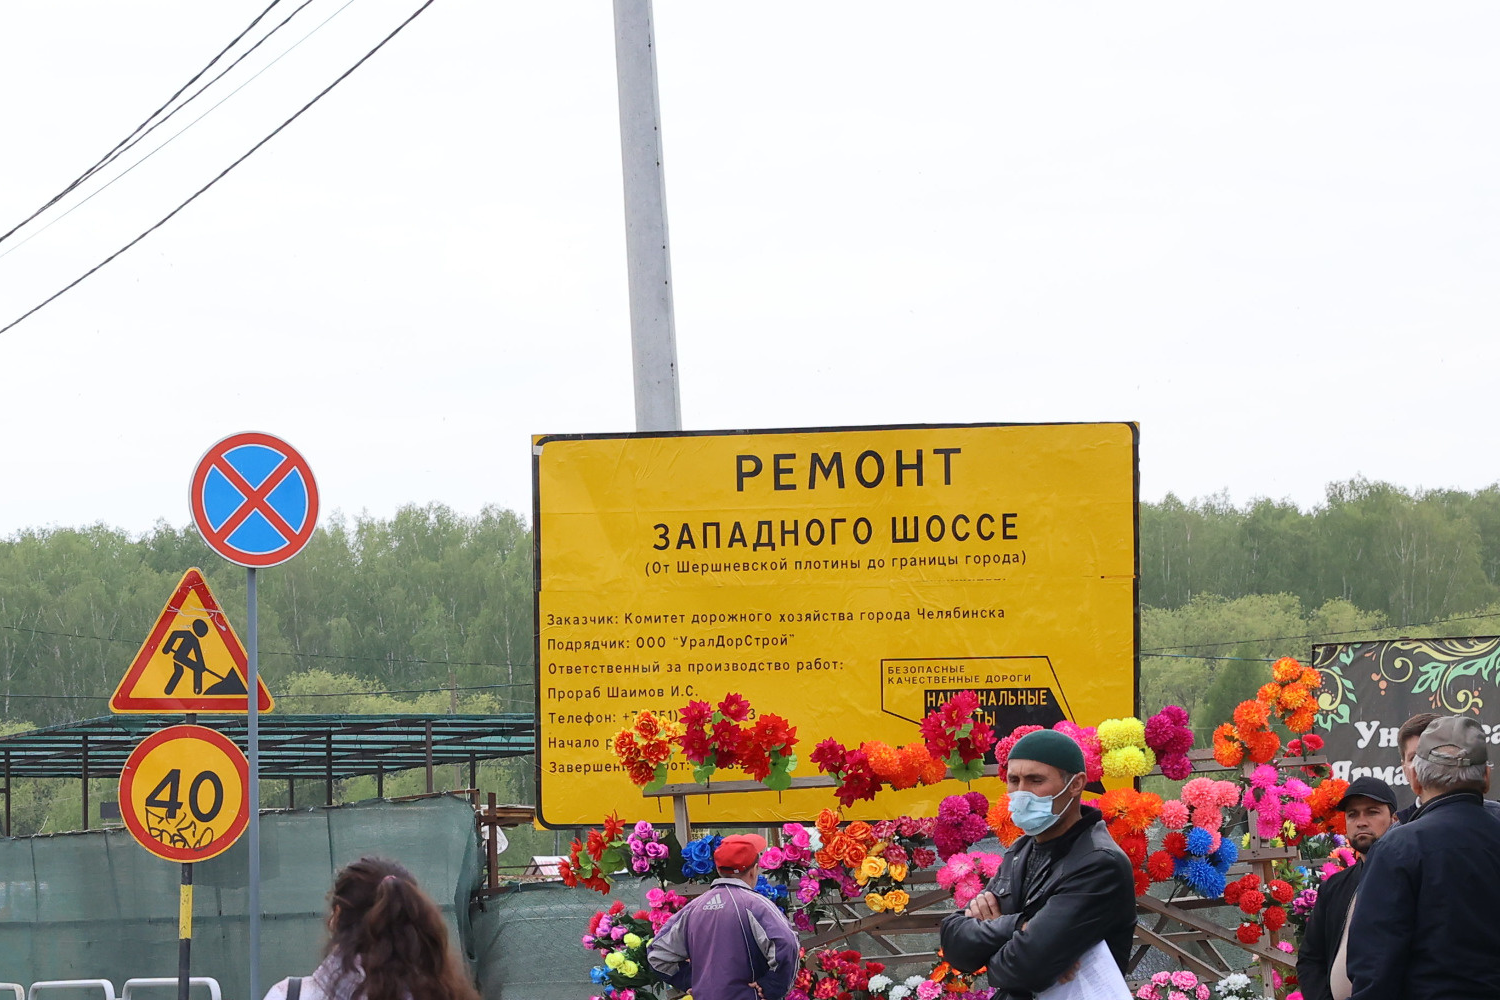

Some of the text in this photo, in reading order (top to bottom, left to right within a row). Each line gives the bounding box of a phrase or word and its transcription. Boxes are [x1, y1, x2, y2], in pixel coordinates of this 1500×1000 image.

[736, 447, 962, 492] РЕМОНТ
[652, 512, 1019, 552] ЗАПАДНОГО ШОССЕ
[645, 550, 1027, 577] (От Шершневской плотины до границы города)
[546, 606, 1006, 626] Заказчик: Комитет дорожного хозяйства города Челябинска
[547, 638, 631, 652] Подрядчик:
[636, 636, 667, 649] ООО
[548, 657, 844, 676] Ответственный за производство работ:
[887, 664, 966, 675] БЕЗОПАСНЫЕ
[887, 674, 1032, 685] КАЧЕСТВЕННЫЕ ДОРОГИ
[547, 685, 699, 702] Прораб Шаимов И.С.
[548, 711, 616, 727] Телефон:
[548, 736, 600, 749] Начало
[144, 768, 224, 823] 40
